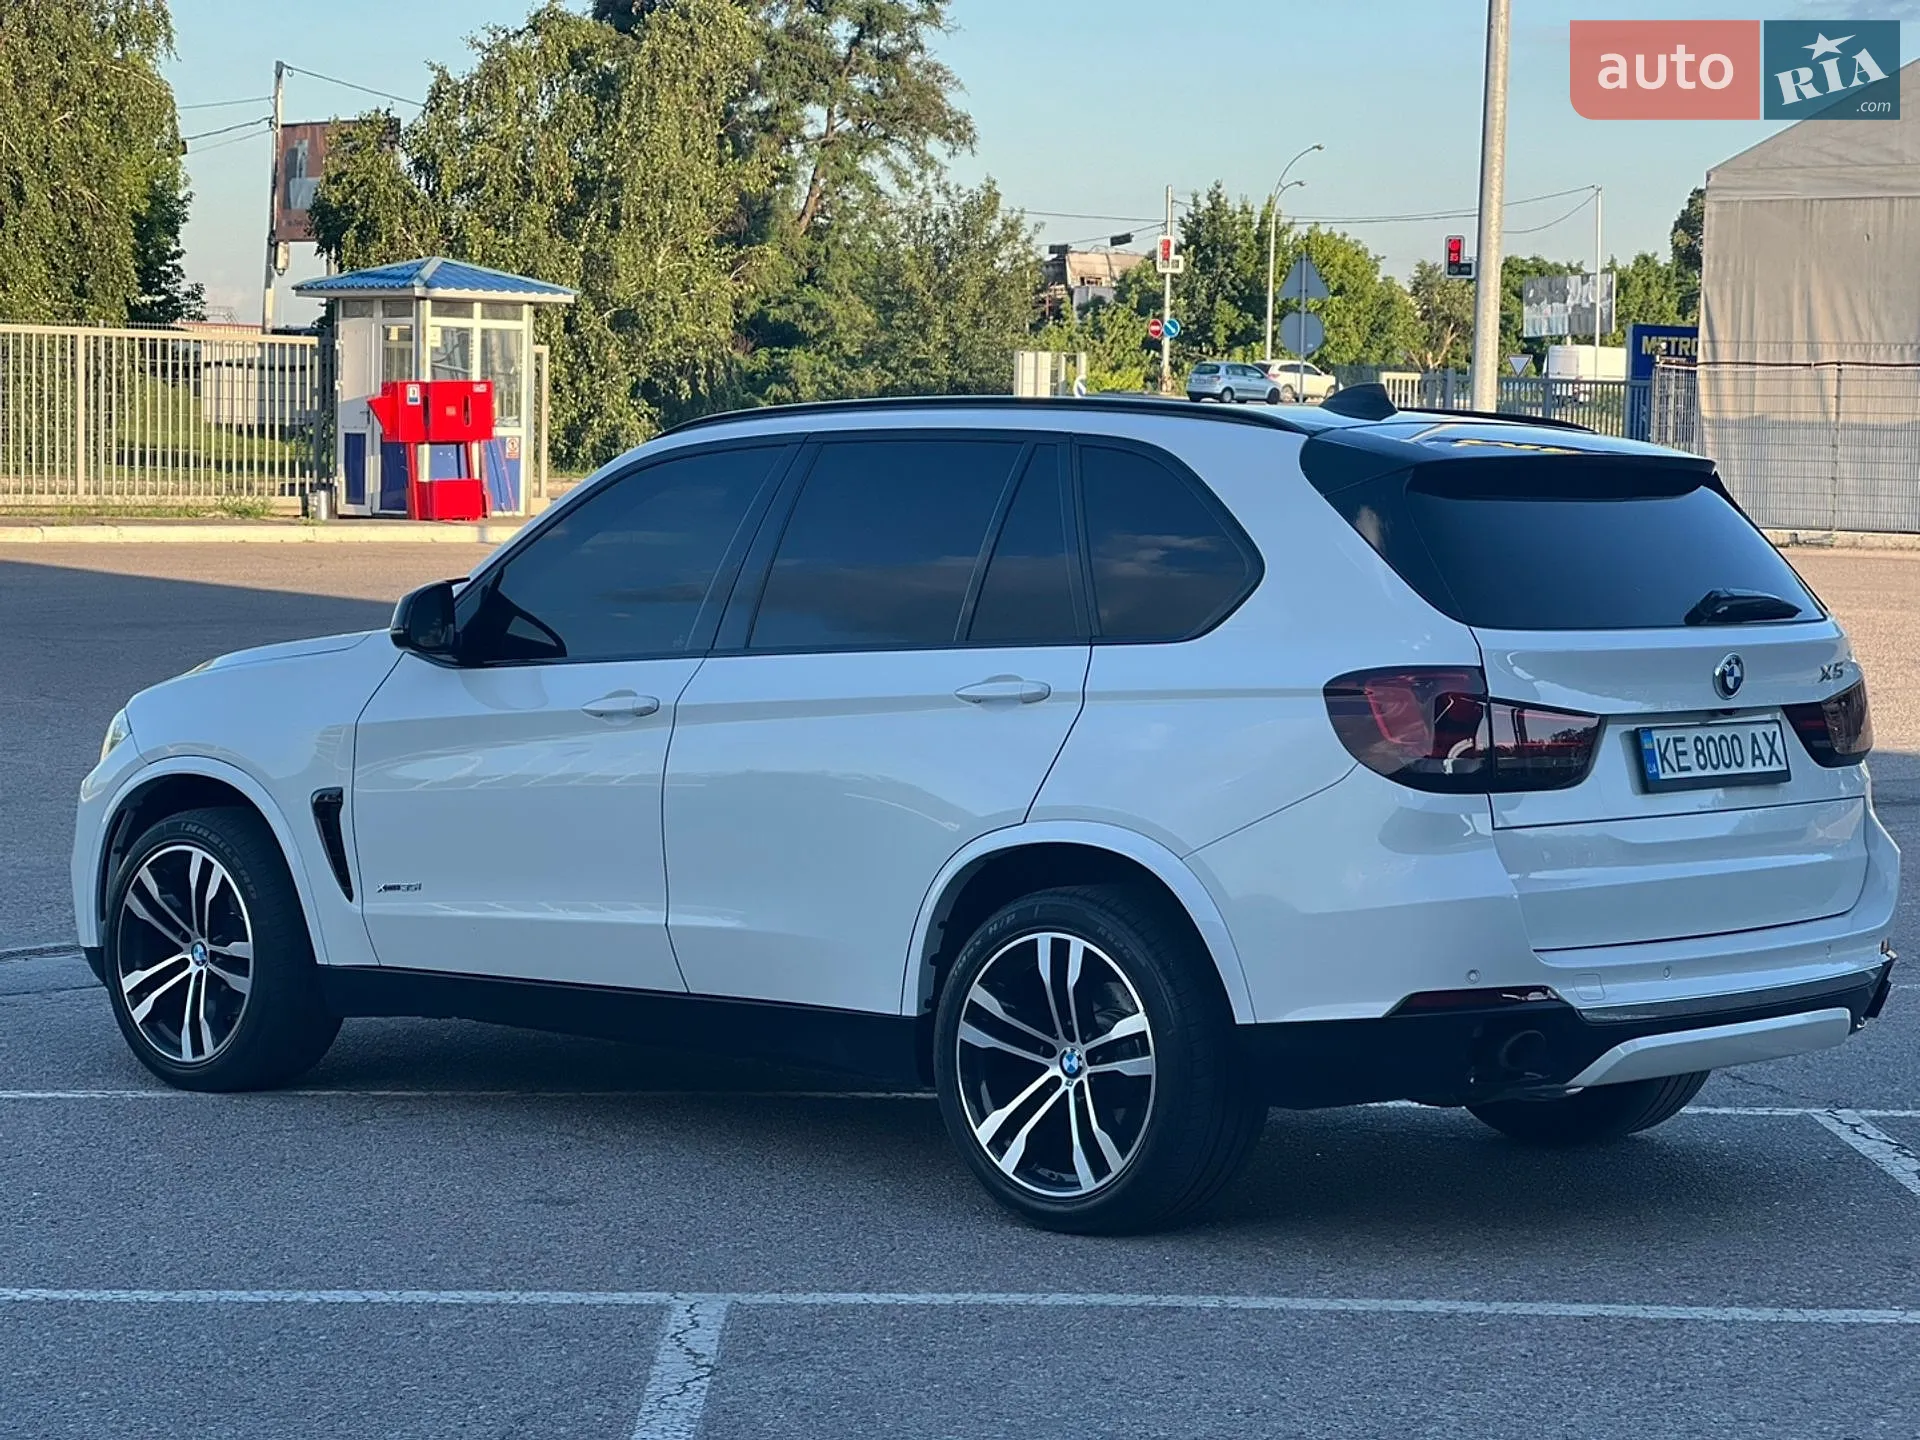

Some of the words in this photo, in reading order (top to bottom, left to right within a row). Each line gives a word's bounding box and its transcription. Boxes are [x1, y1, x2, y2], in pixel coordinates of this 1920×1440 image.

[1818, 661, 1844, 683] X5
[1656, 736, 1692, 774] KE
[1693, 733, 1745, 771] 8000
[1751, 730, 1783, 767] AX
